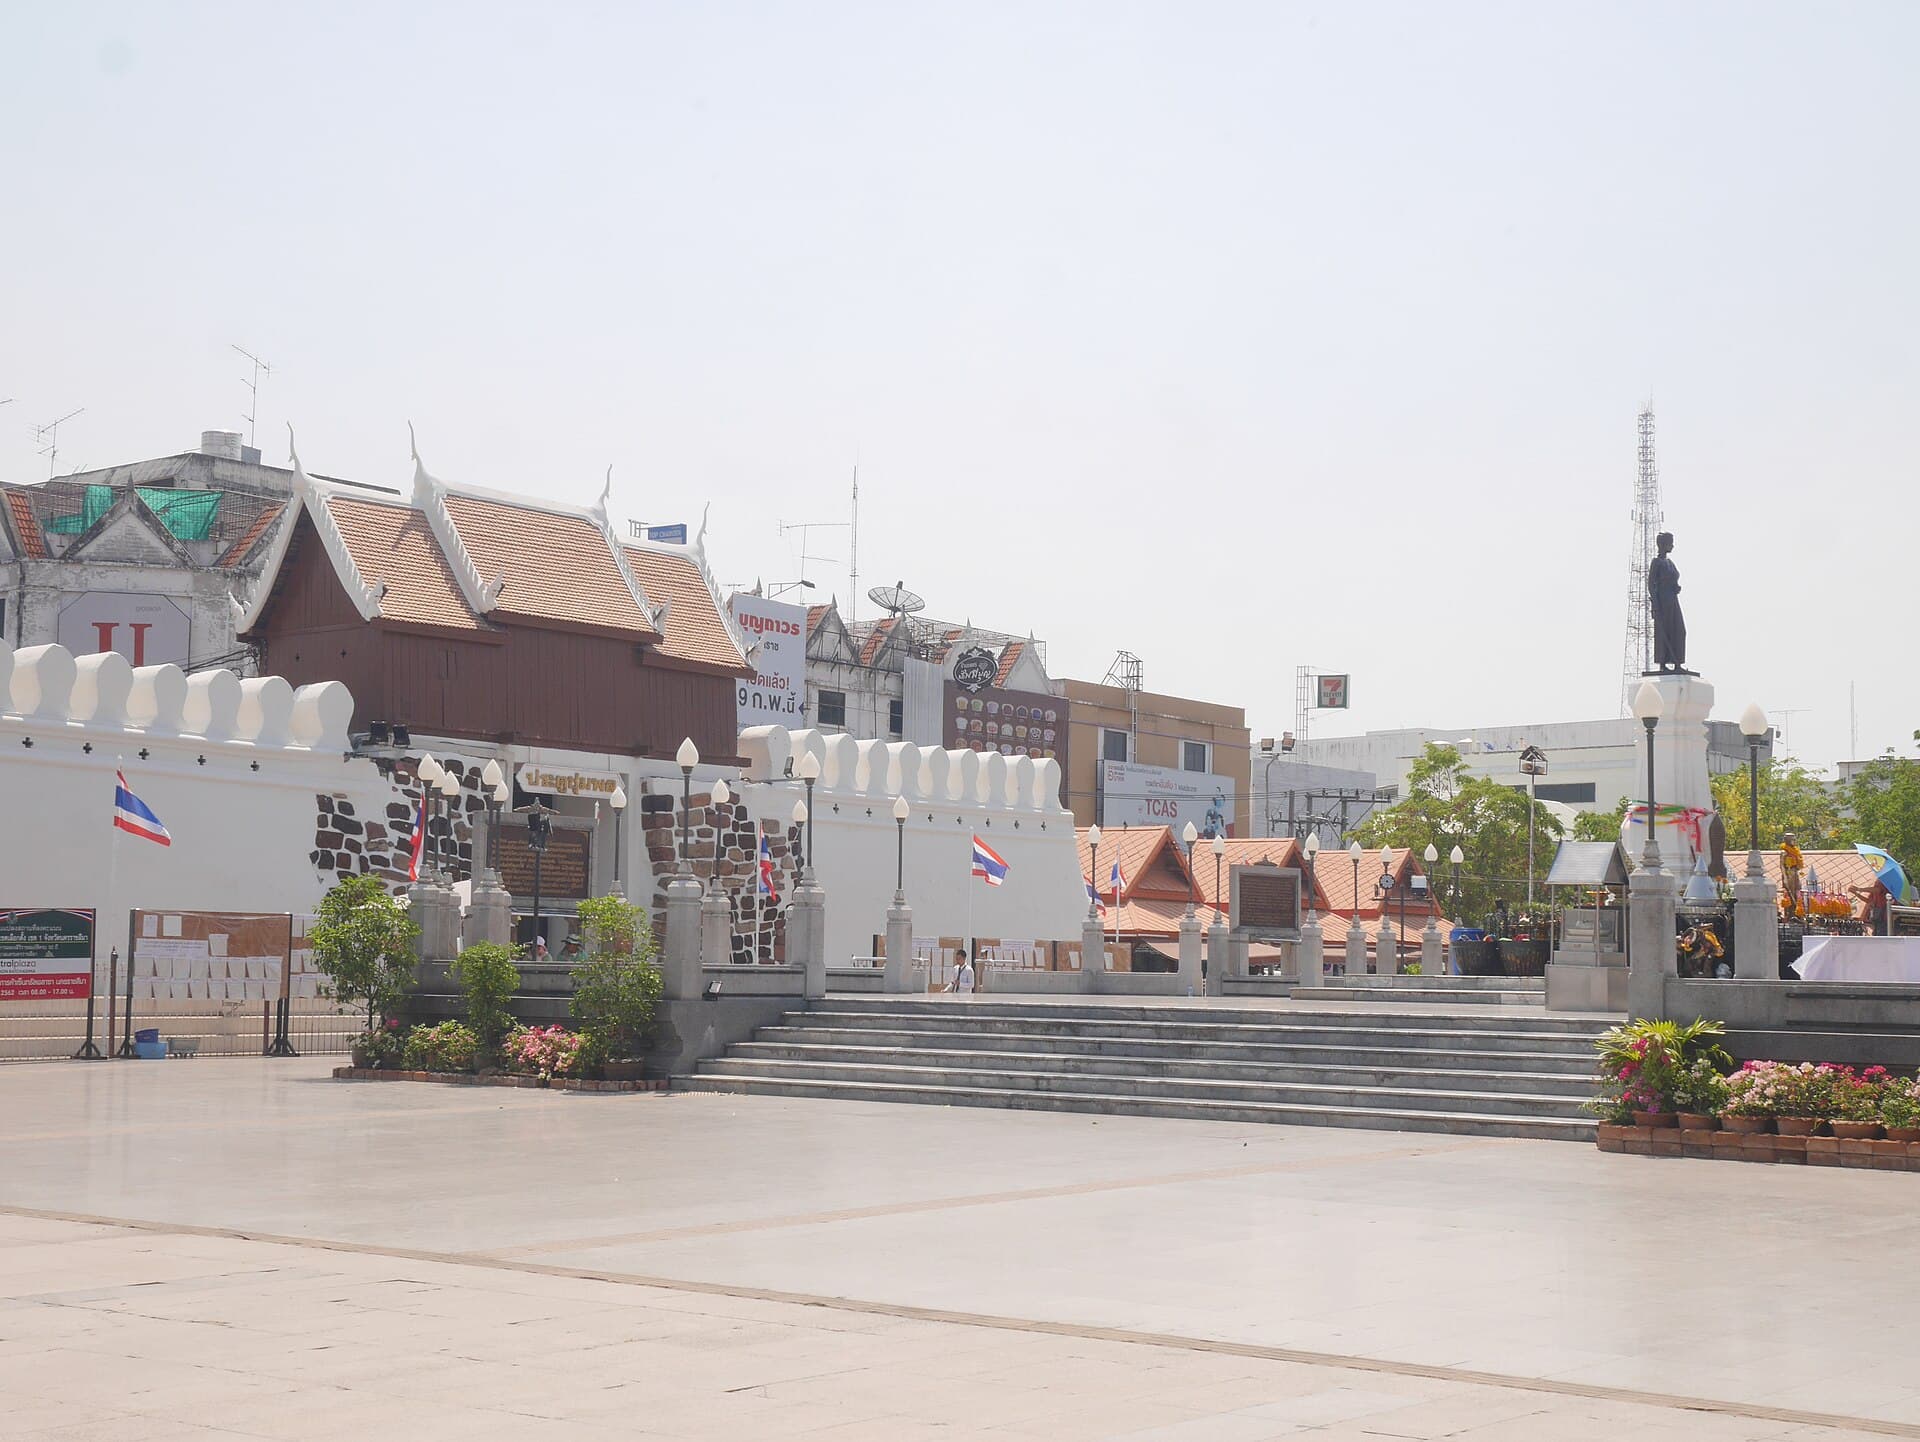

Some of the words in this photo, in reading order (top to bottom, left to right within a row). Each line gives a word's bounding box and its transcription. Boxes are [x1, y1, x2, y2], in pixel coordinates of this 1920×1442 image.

[740, 612, 800, 635] บุญถาวร
[1323, 679, 1342, 707] 7
[1145, 799, 1178, 818] TCAS
